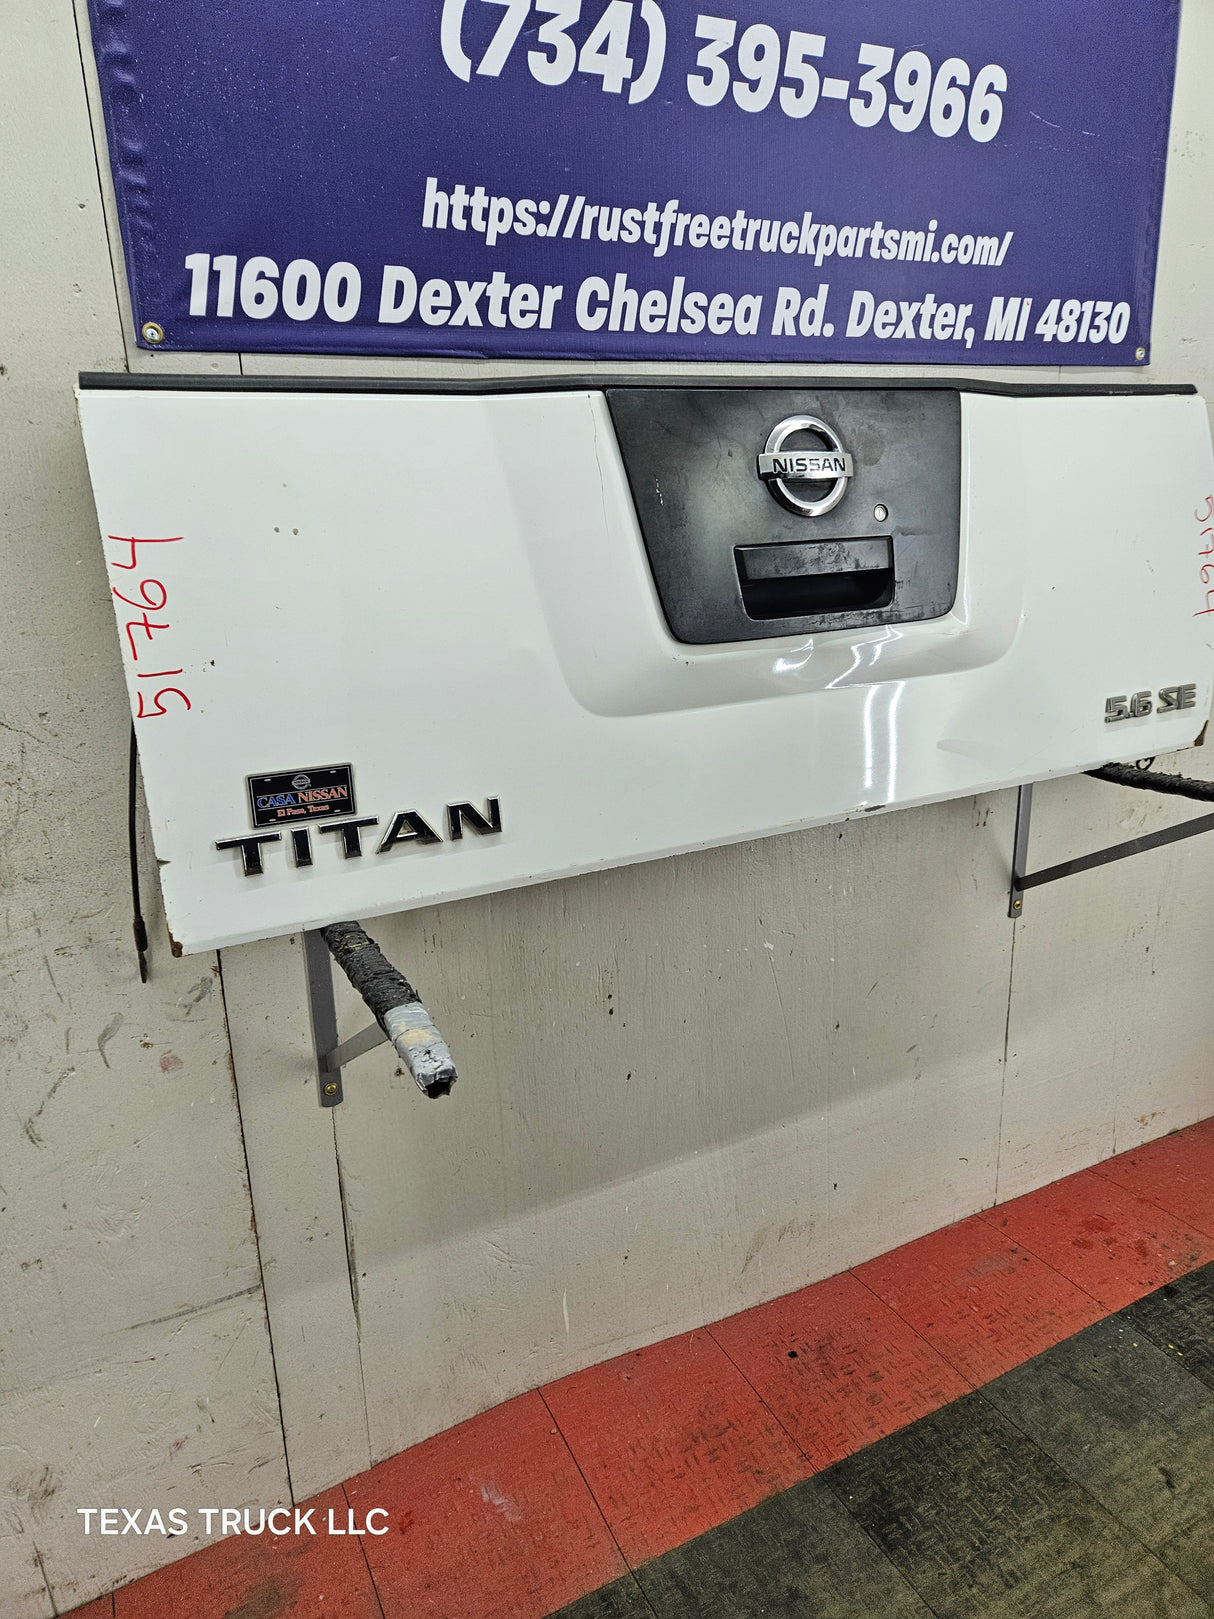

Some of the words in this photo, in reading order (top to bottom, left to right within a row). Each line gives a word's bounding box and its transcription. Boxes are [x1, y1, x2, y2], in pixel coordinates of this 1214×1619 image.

[441, 0, 666, 104] (734)
[687, 14, 1009, 143] 395-3966
[422, 176, 1014, 267] https://rustfreetruckpartsmi.com/
[185, 253, 361, 322] 11600
[378, 264, 563, 329] Dexter
[576, 273, 763, 335] Chelsea
[771, 284, 835, 338] Rd.
[846, 290, 975, 348] Dexter,
[984, 296, 1033, 342] MI
[1034, 299, 1131, 344] 48130
[772, 456, 847, 474] NISSAN
[108, 535, 191, 718] 51764
[1104, 690, 1152, 723] 5.6
[1156, 683, 1197, 713] SE
[215, 796, 502, 877] TITAN
[257, 793, 296, 809] CASA
[297, 786, 348, 804] NISSAN
